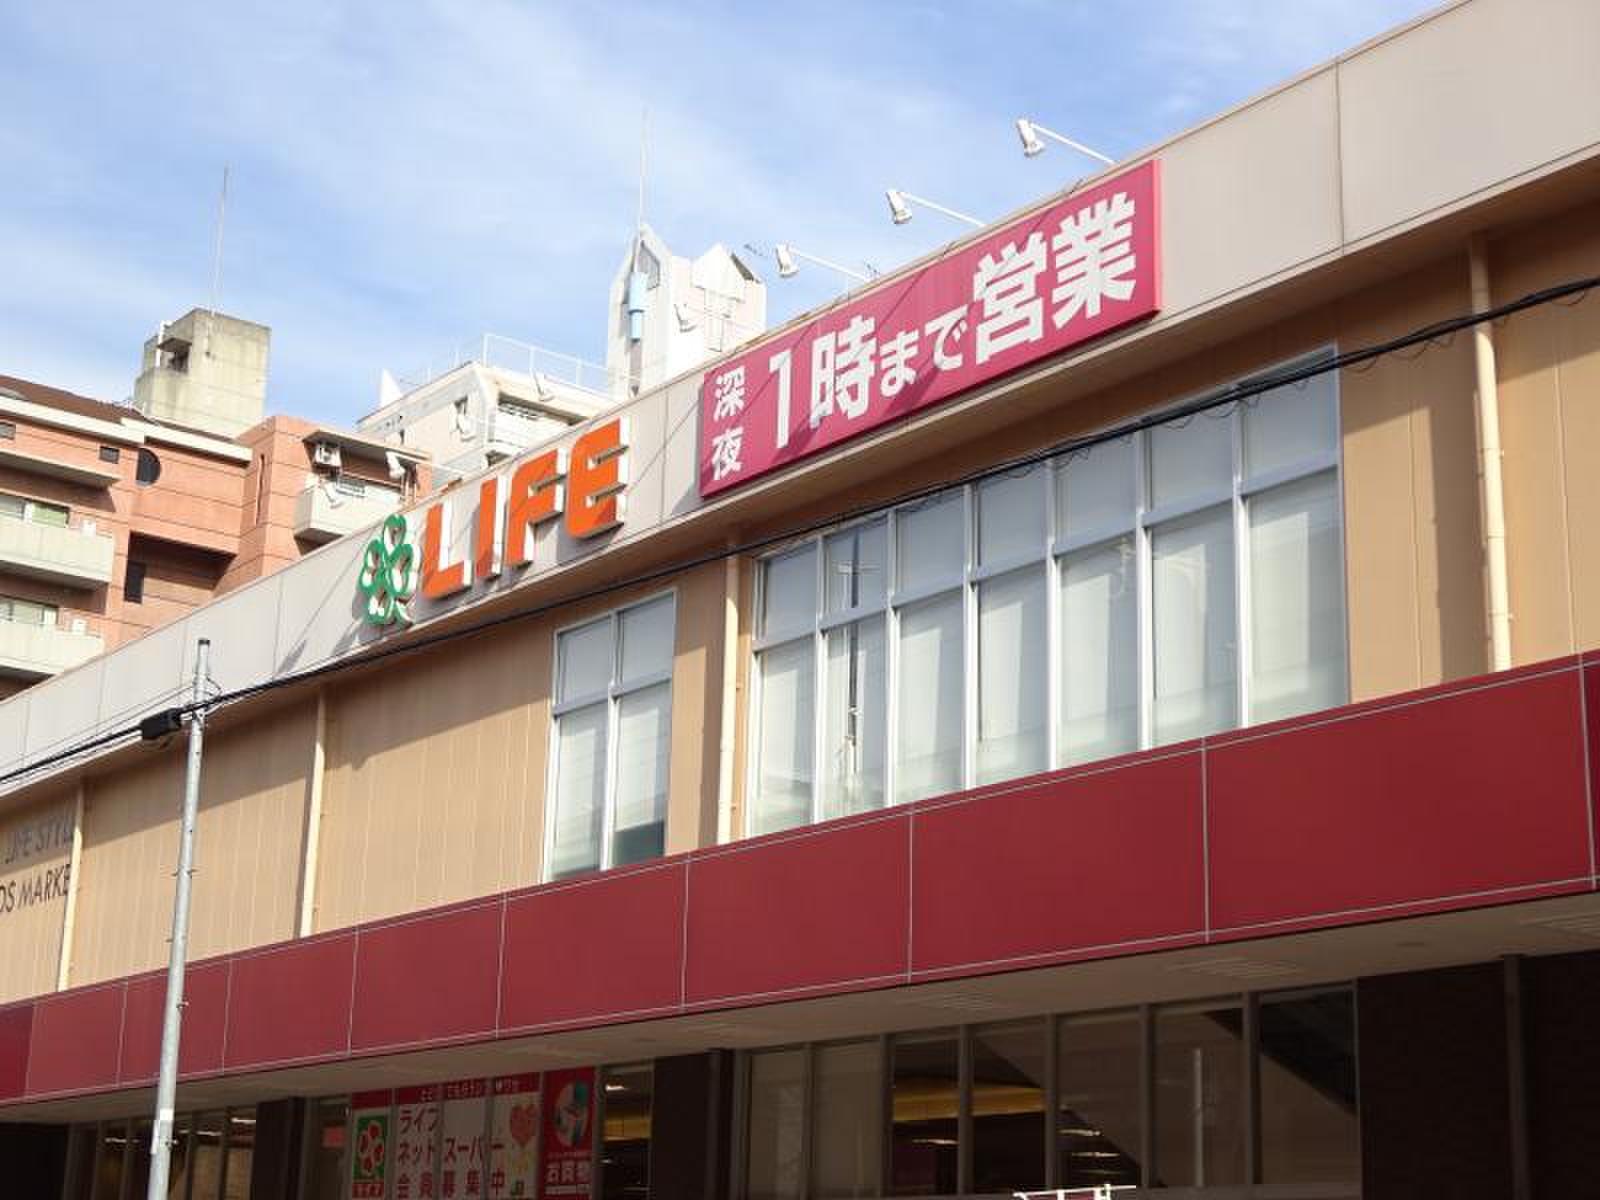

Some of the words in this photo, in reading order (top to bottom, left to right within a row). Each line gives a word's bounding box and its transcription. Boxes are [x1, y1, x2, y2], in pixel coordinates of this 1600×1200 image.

[768, 191, 1136, 449] 1時まで営業
[711, 365, 746, 481] 深夜
[422, 417, 629, 599] LIFE
[400, 1107, 441, 1134] ライフ
